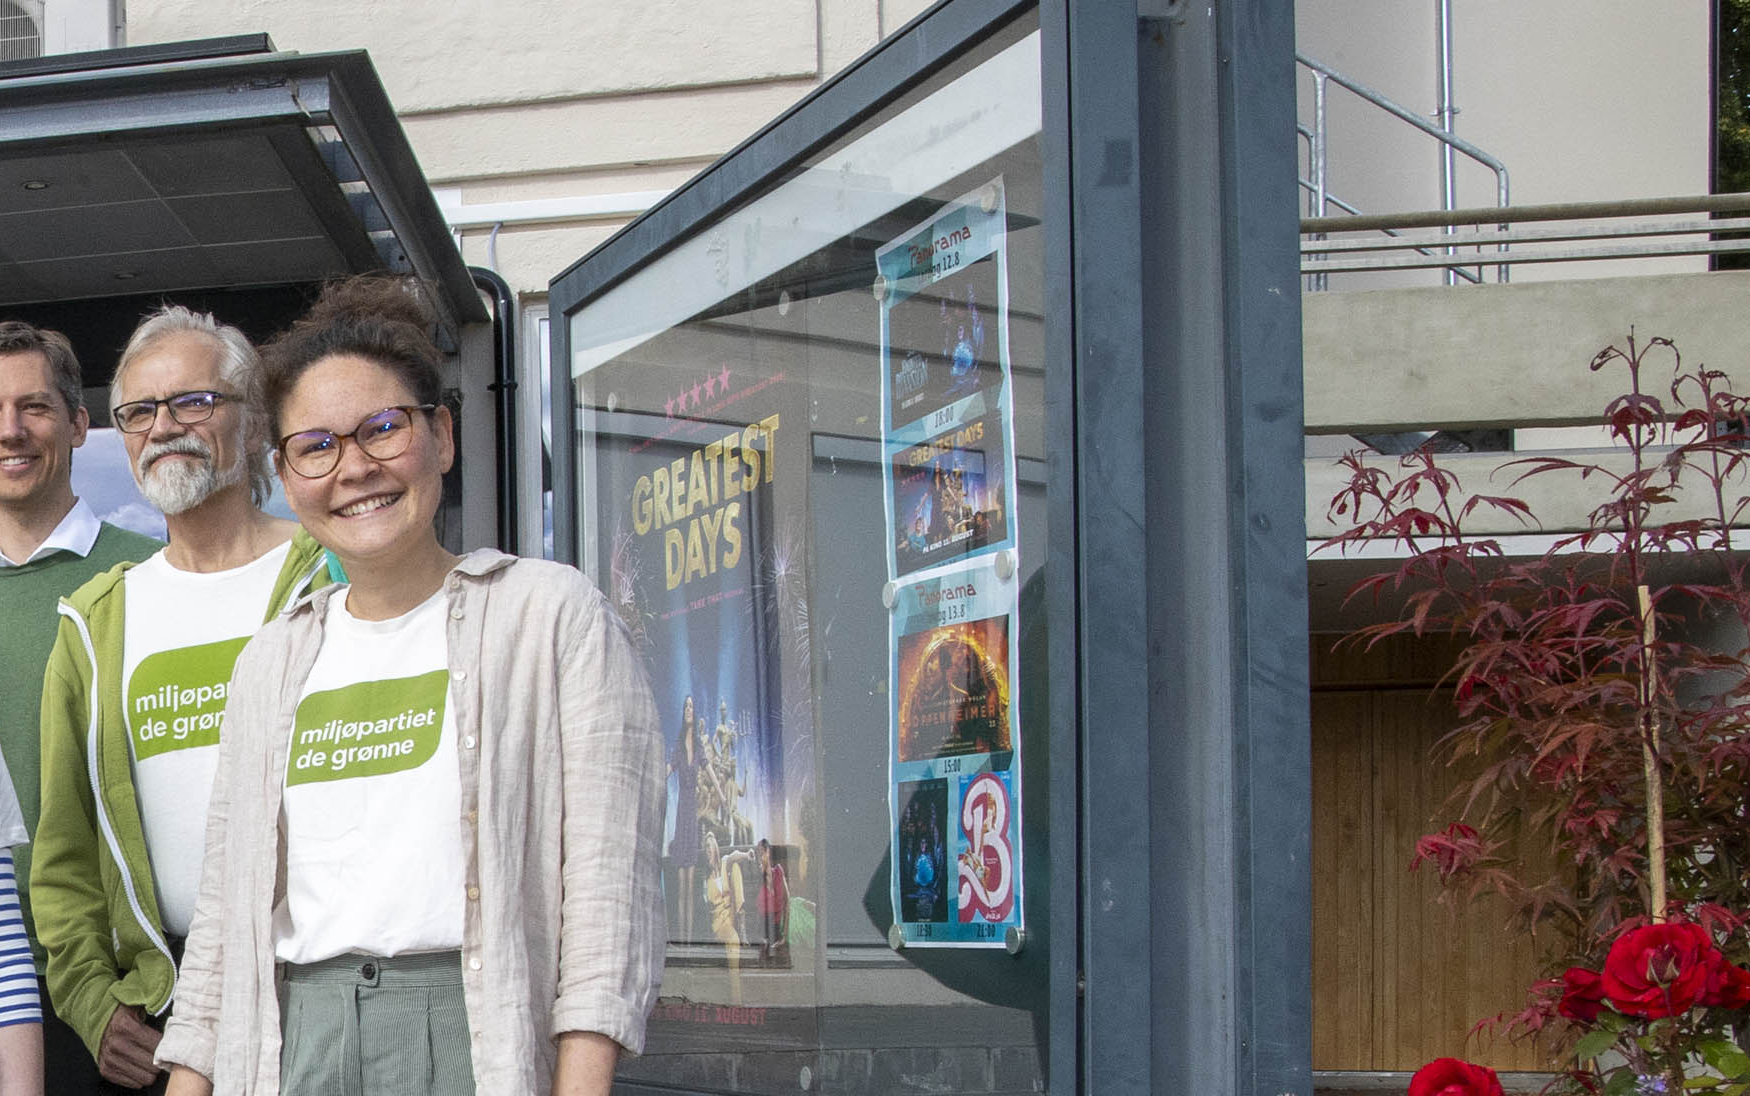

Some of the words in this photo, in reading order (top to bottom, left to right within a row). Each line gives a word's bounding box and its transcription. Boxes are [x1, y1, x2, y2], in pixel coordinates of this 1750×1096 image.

[908, 226, 971, 268] Panorama
[942, 251, 960, 271] 12.8
[956, 421, 985, 446] DAYS
[632, 413, 780, 536] GREATEST
[665, 502, 742, 591] DAYS
[915, 583, 977, 608] Panorama
[948, 603, 965, 620] 13.8
[139, 717, 168, 741] de
[300, 708, 437, 745] miljøpartiet
[296, 749, 327, 770] de
[331, 739, 415, 771] grønne
